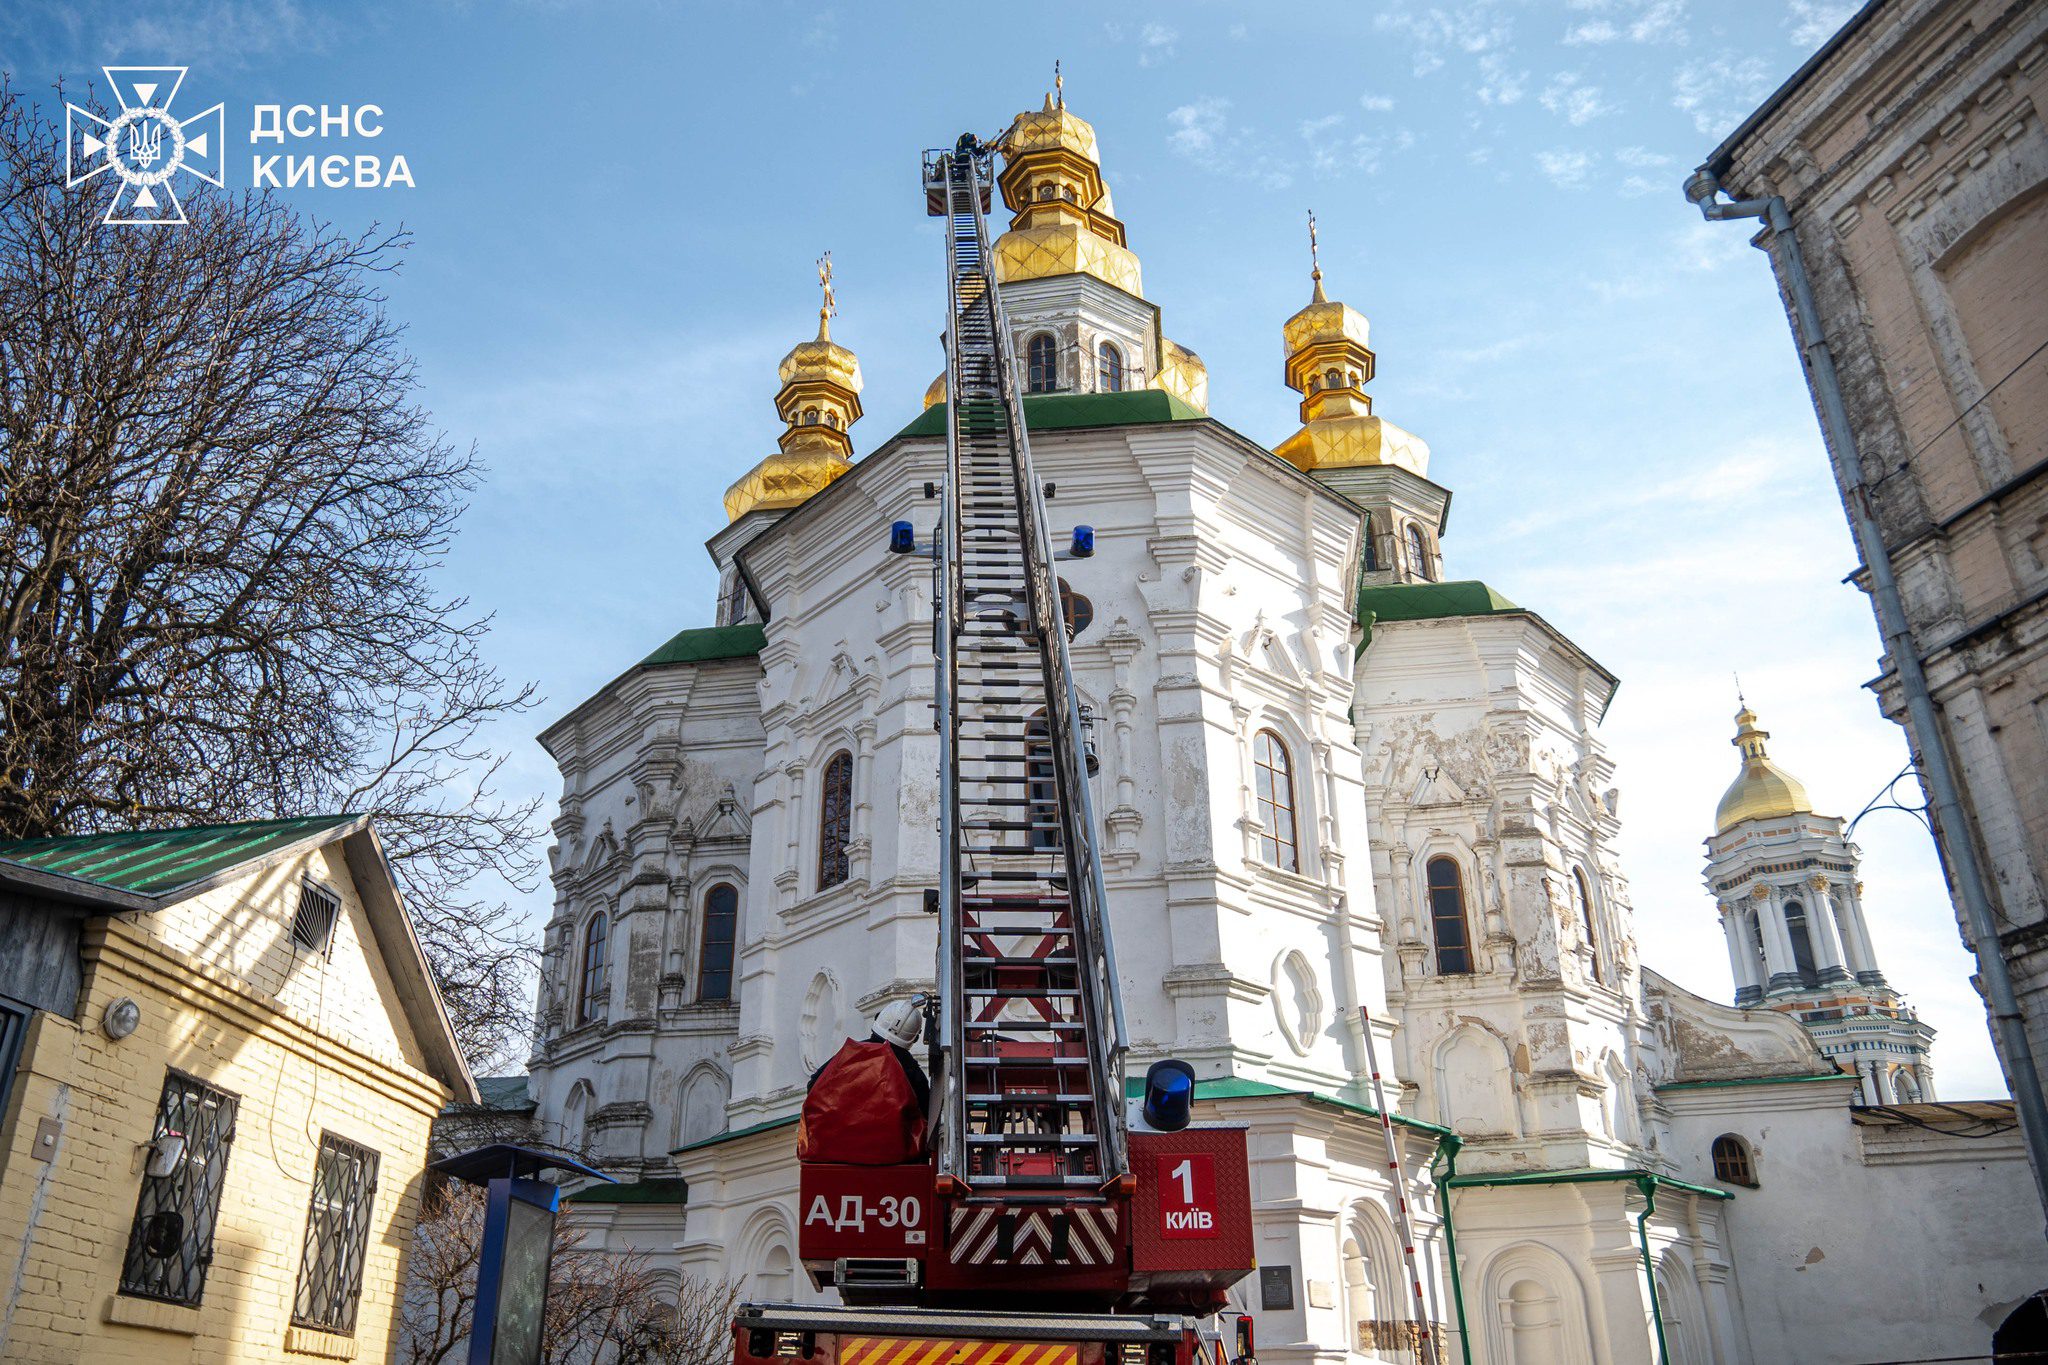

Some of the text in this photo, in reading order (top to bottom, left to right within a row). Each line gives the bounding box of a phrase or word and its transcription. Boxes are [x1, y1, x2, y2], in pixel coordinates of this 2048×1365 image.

[1171, 1159, 1194, 1204] 1
[804, 1194, 921, 1233] АД-30
[1165, 1207, 1213, 1229] КИЇВ
